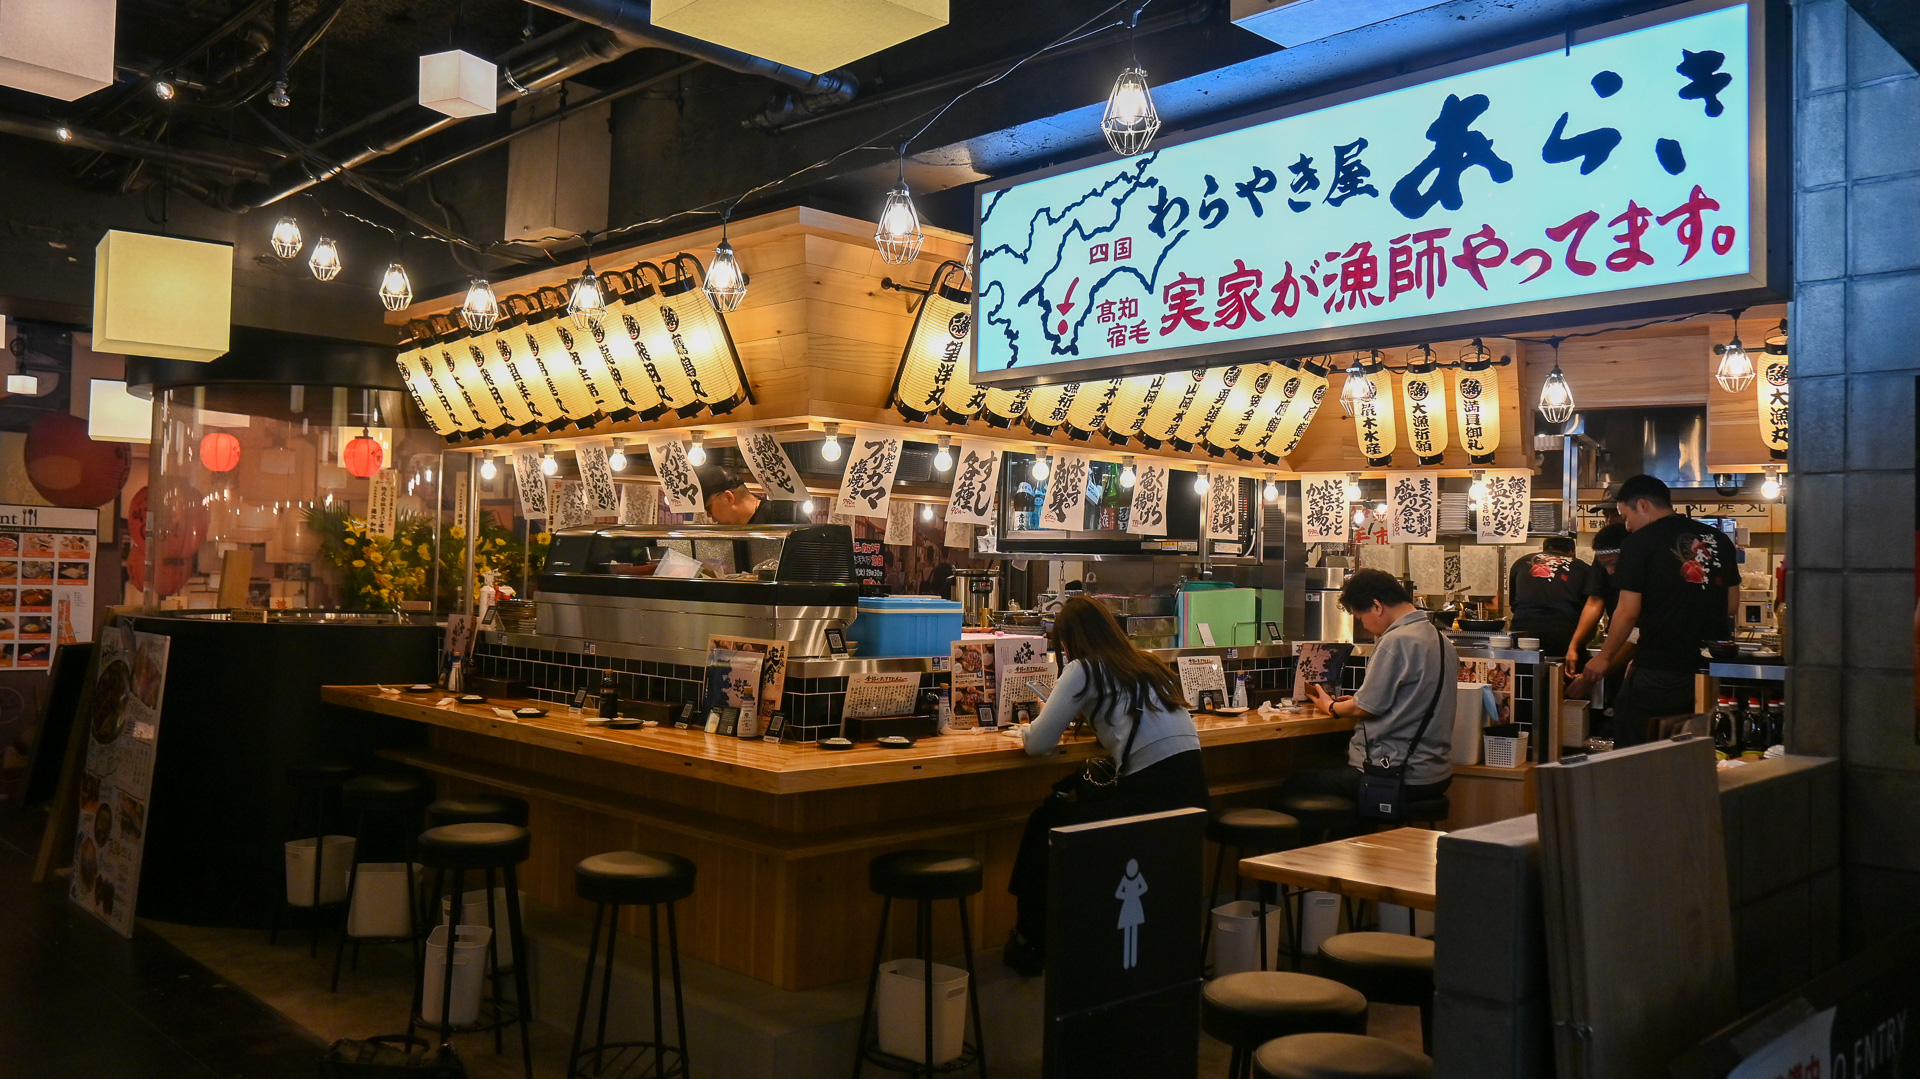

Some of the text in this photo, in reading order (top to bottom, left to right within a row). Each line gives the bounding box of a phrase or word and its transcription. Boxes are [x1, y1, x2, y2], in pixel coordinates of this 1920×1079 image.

[1390, 48, 1733, 219] あらき
[1148, 136, 1380, 237] わらやき屋
[1089, 236, 1133, 265] 四国
[1159, 184, 1736, 336] 実家が漁師やってます。
[1106, 319, 1151, 348] 宿毛
[924, 339, 964, 407] 望洋丸
[1411, 402, 1433, 452] 大漁祈願
[1462, 399, 1485, 451] 満員御礼
[655, 441, 699, 506] ブリカマ
[659, 462, 681, 500] 塩焼き
[846, 458, 868, 500] 塩焼き
[859, 438, 889, 510] ブリカマ
[882, 438, 898, 475] 高知産
[952, 449, 982, 513] 各種
[973, 450, 998, 517] すし
[1048, 456, 1070, 524] 刺身
[1133, 465, 1157, 526] 竜田揚げ
[1150, 467, 1165, 526] くじら
[1218, 475, 1236, 535] お刺身
[1305, 482, 1335, 537] かき揚げ
[1318, 479, 1335, 512] 小柱の
[1332, 479, 1345, 536] とうもろこしと
[1393, 477, 1421, 534] 盛り合わせ
[1416, 477, 1433, 538] まぐろの刺身
[1485, 476, 1511, 537] 塩たたき
[1506, 475, 1527, 538] 鰹のわら焼き
[1854, 1007, 1908, 1079] ENTRY
